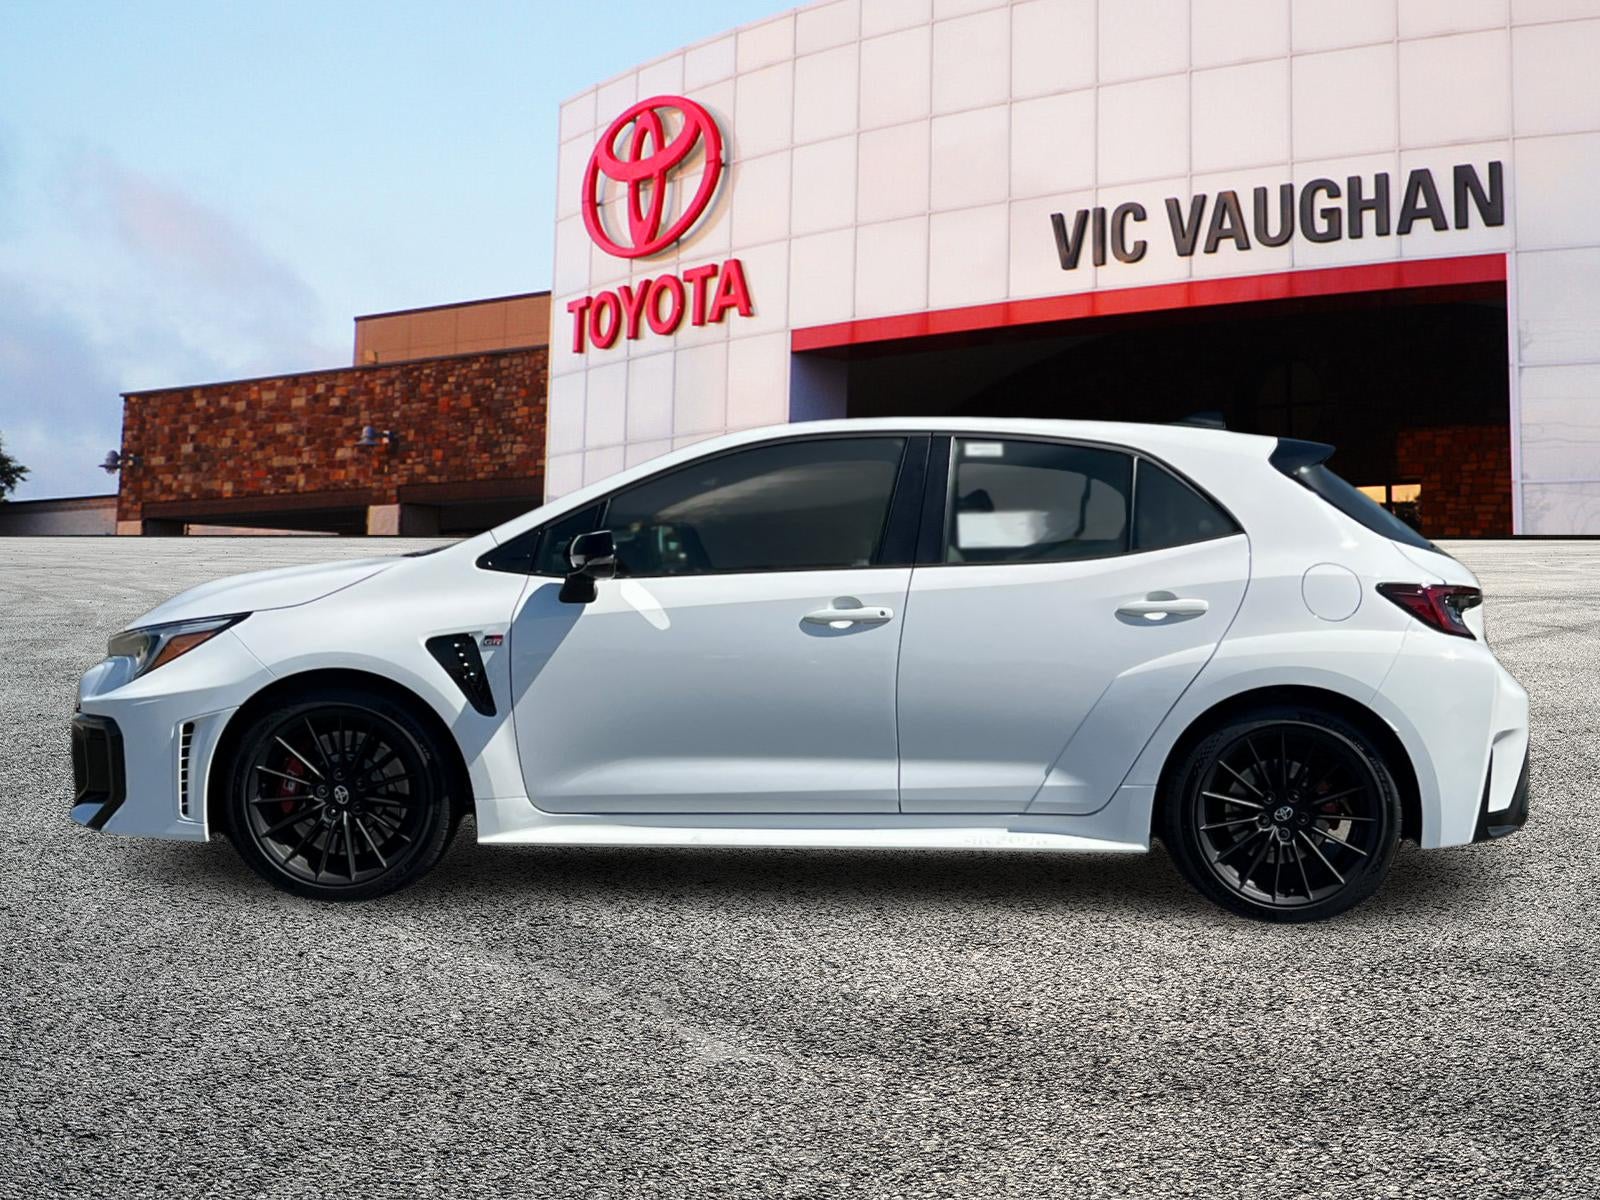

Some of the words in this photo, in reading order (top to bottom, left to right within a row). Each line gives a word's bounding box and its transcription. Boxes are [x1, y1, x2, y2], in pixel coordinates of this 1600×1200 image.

[1051, 202, 1147, 271] VIC
[1165, 161, 1505, 257] VAUGHAN
[567, 258, 754, 354] TOYOTA
